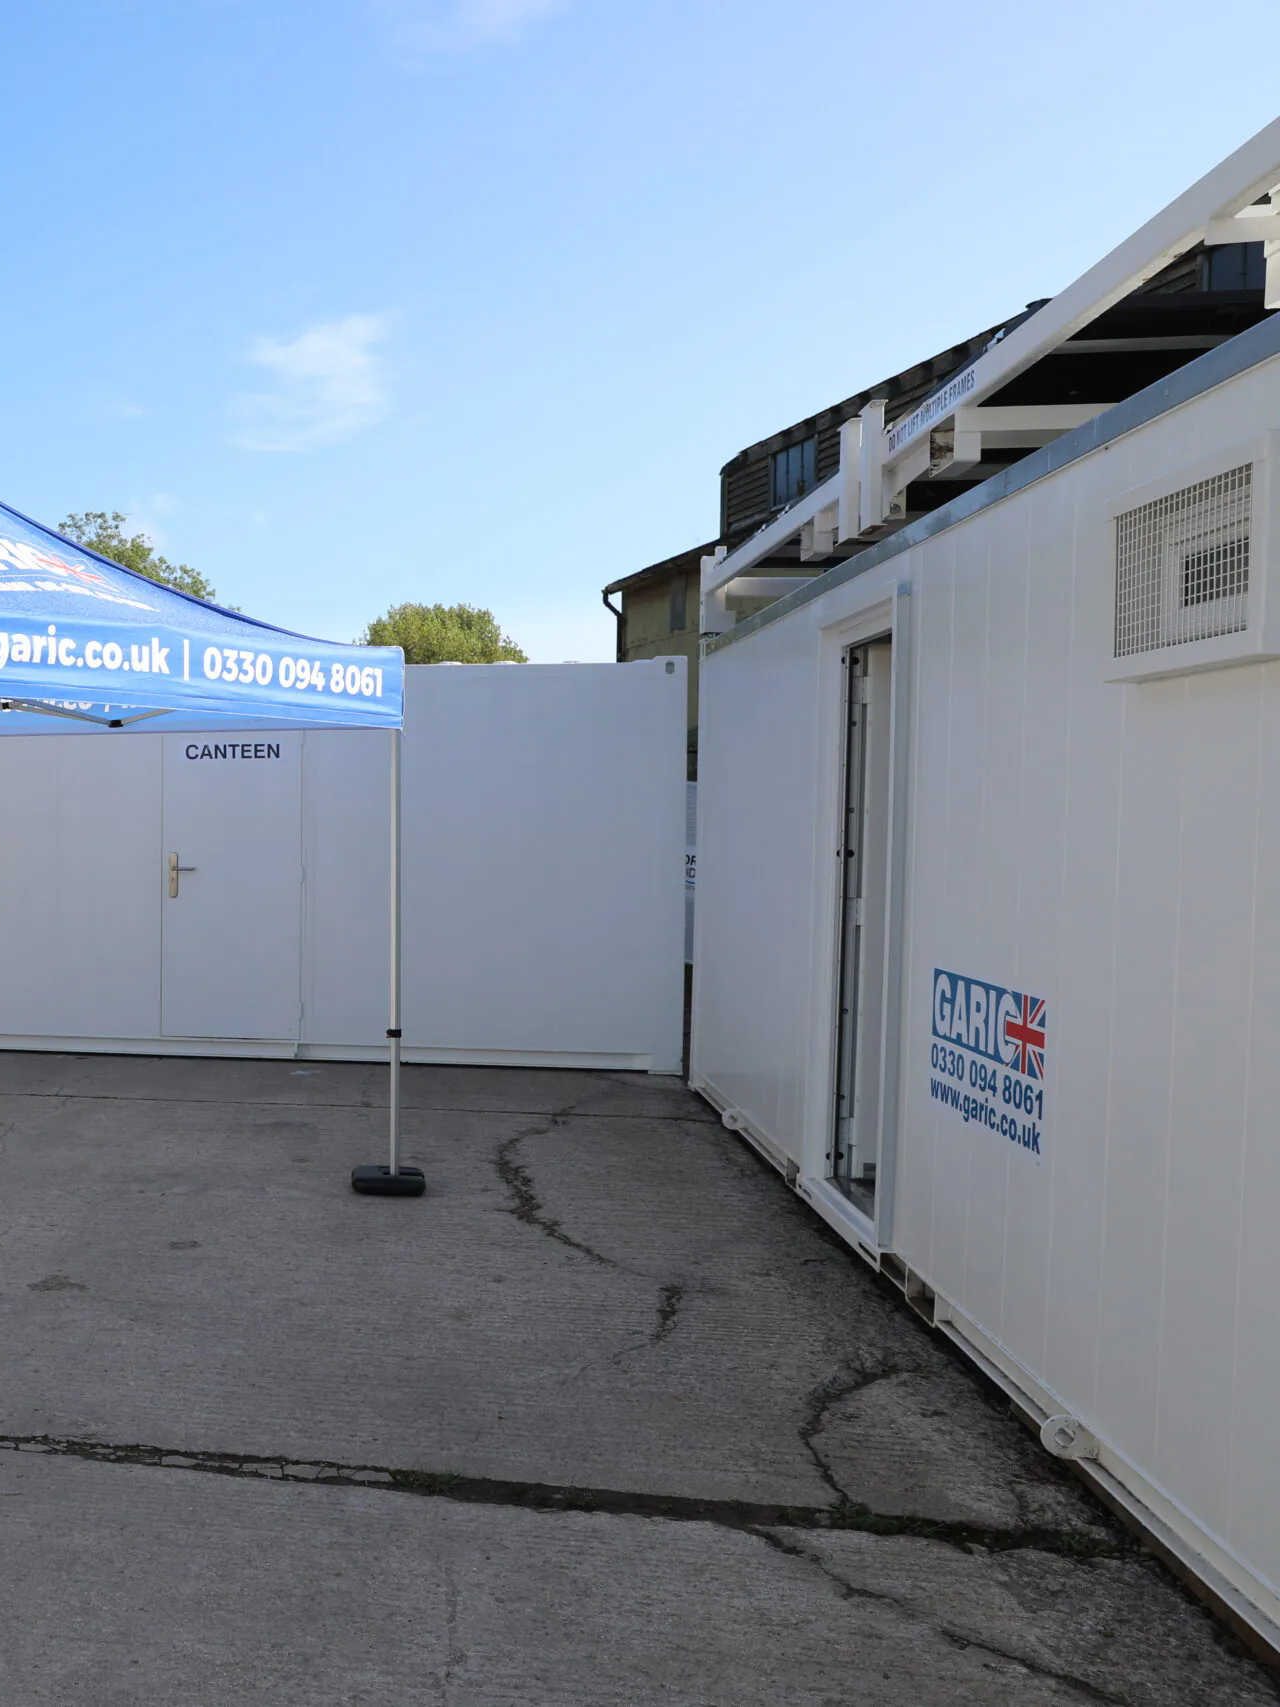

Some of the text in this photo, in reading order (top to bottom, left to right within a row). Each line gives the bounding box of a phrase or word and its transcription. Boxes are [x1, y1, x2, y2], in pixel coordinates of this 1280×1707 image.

[908, 413, 920, 437] LIFT
[949, 369, 975, 404] FRAMES
[203, 646, 273, 686] 0330
[278, 656, 325, 691] 094
[330, 663, 383, 697] 8061
[186, 743, 280, 760] CANTEEN
[934, 973, 1021, 1064] GARIC
[930, 1077, 1040, 1155] www.garic.co.uk
[931, 1042, 1044, 1120] 0330 094 8061
